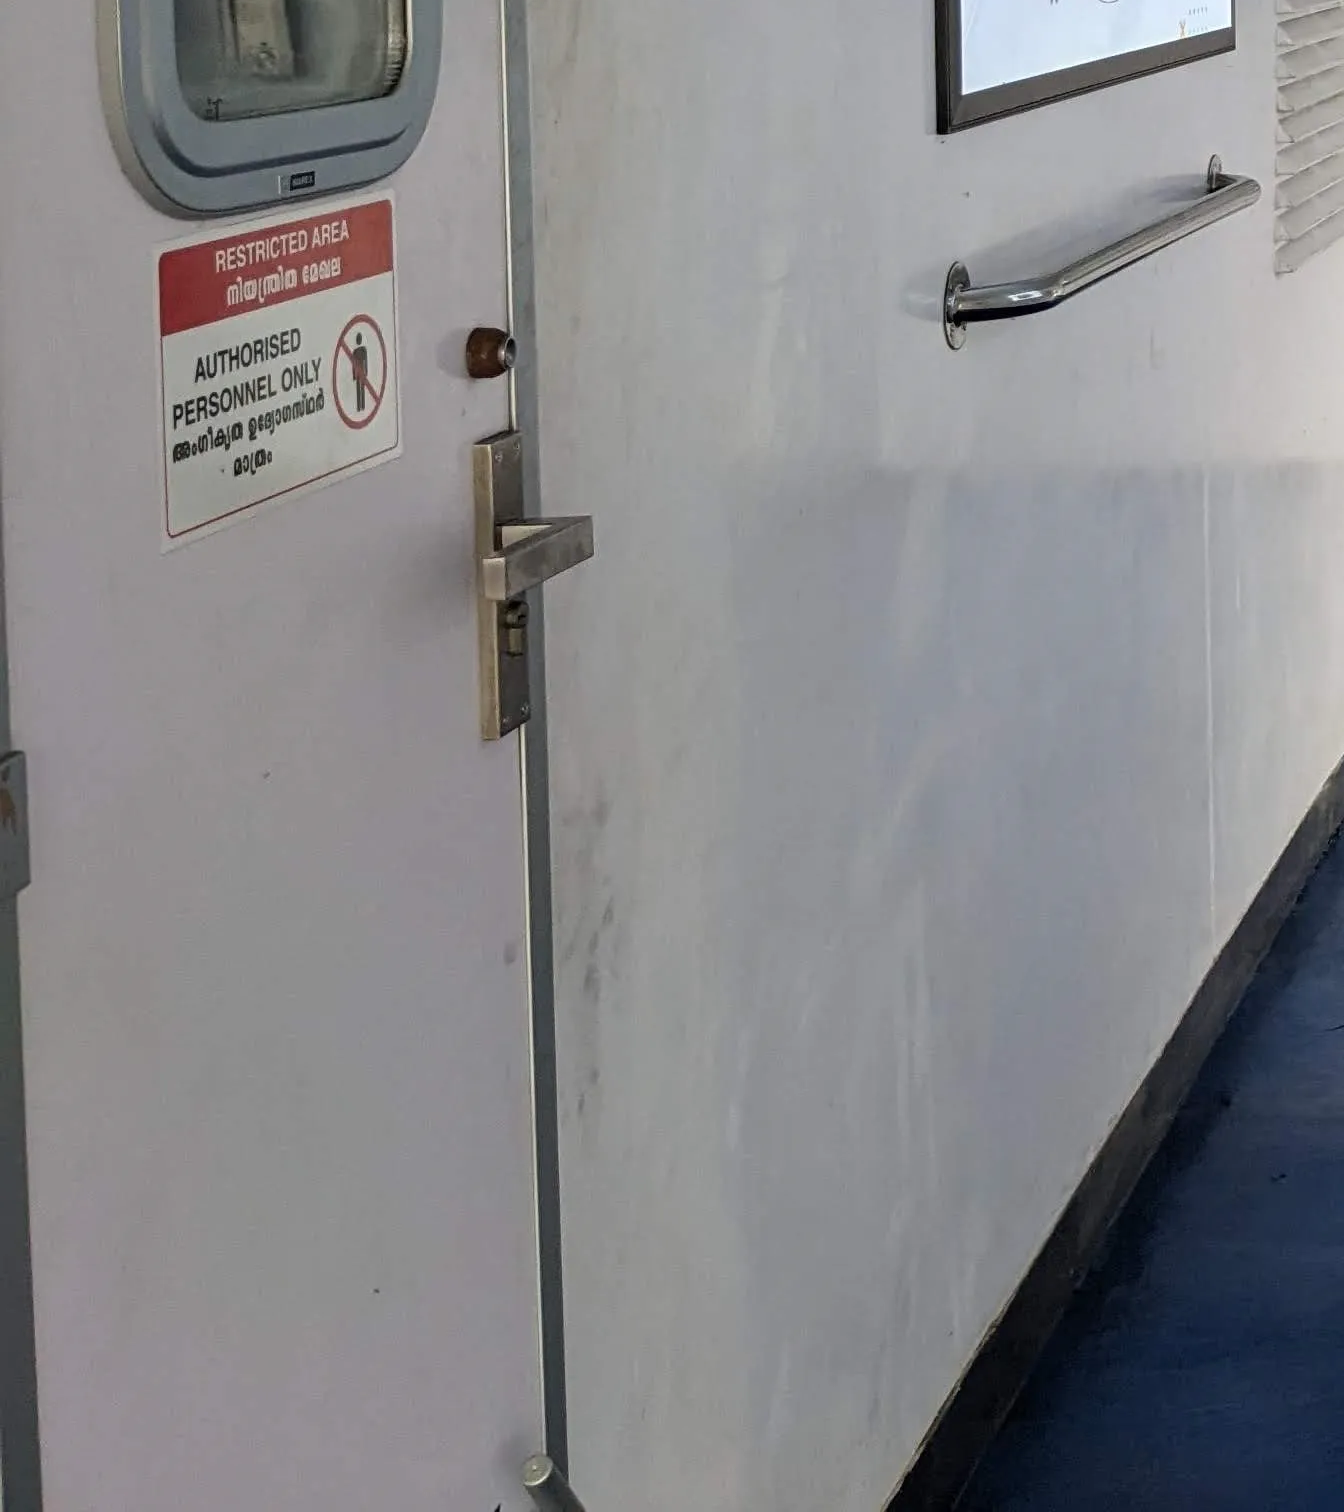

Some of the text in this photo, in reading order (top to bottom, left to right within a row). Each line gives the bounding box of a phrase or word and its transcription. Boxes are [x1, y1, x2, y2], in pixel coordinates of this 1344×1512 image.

[215, 219, 349, 273] RESTRICTED AREA
[195, 328, 301, 383] AUTHORISED
[173, 357, 322, 430] PERSONNEL ONLY
